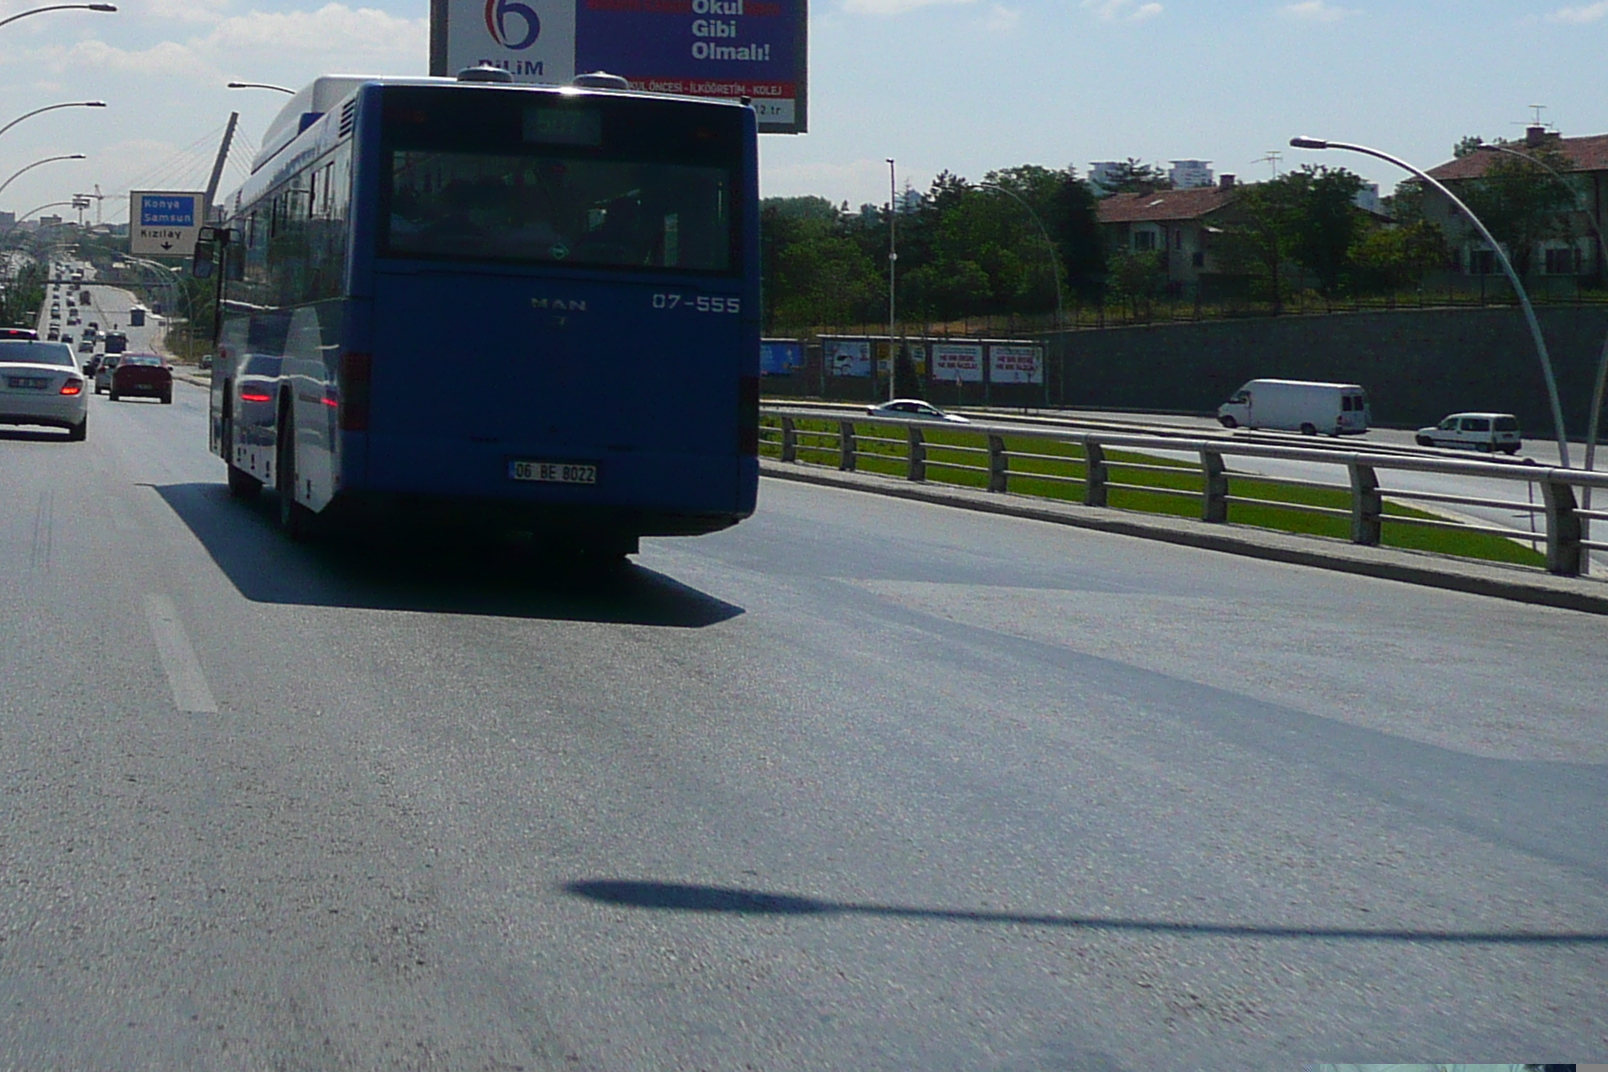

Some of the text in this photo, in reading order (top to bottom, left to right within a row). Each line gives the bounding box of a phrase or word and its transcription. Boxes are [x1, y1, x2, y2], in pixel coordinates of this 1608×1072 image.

[692, 20, 736, 37] Gibi
[692, 42, 770, 61] Olmalı!
[628, 80, 646, 91] KUL
[649, 79, 683, 93] ÖNCESİ
[753, 85, 782, 95] KOLEJ
[144, 199, 180, 209] Konya
[144, 213, 191, 222] Samsun
[531, 297, 586, 311] MAN
[652, 293, 741, 313] 07-555
[516, 463, 595, 482] 06 BE 8022
